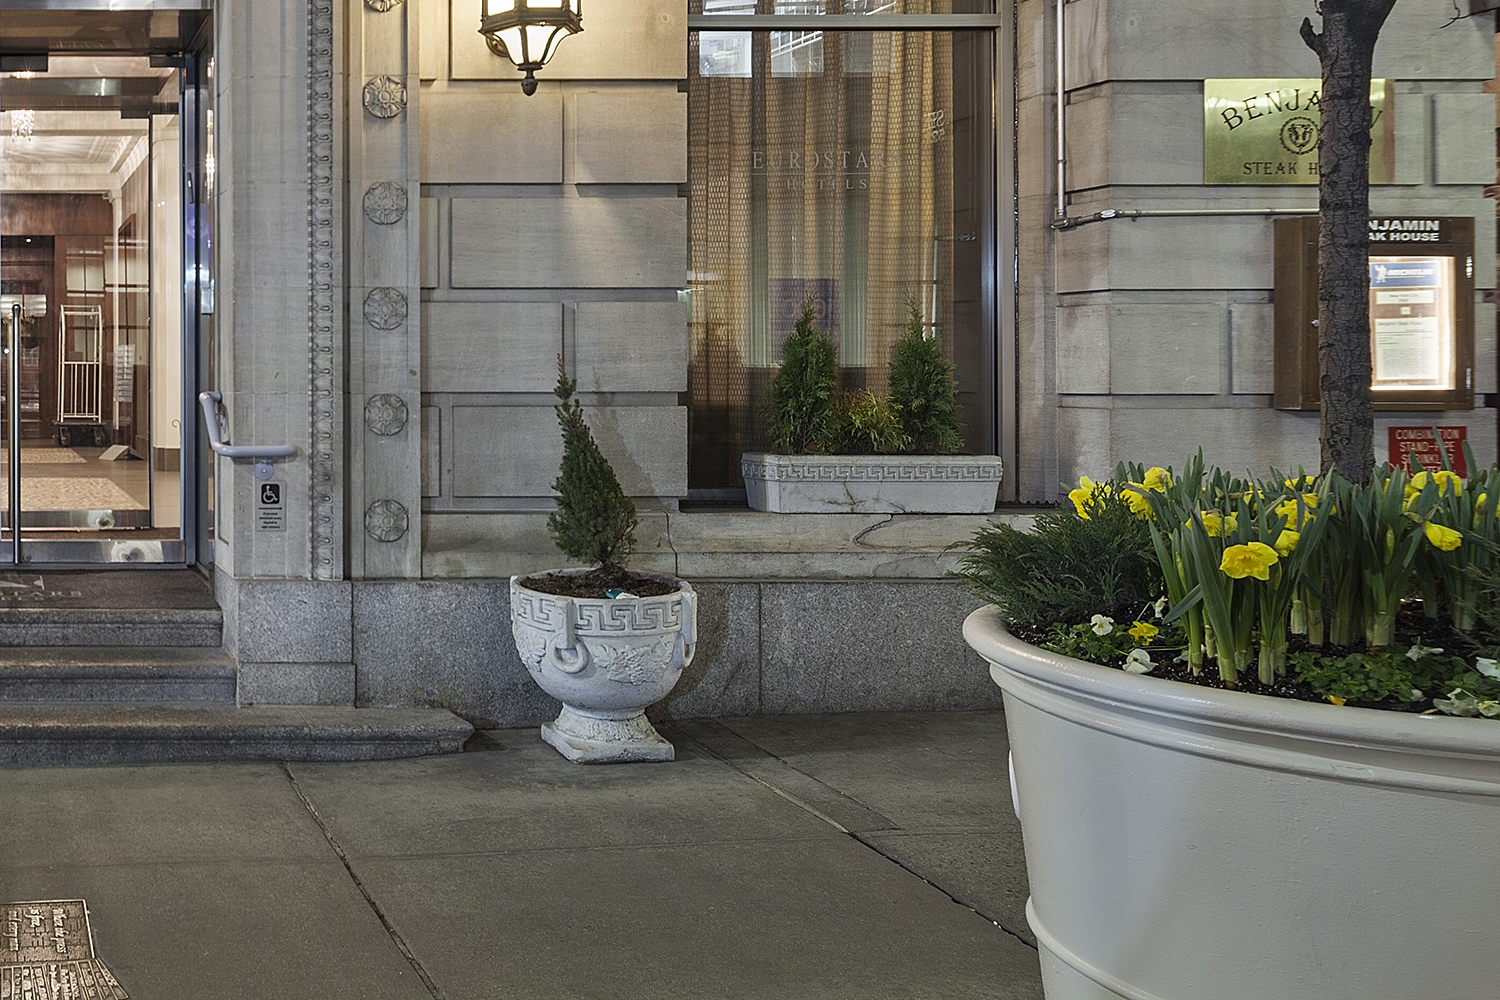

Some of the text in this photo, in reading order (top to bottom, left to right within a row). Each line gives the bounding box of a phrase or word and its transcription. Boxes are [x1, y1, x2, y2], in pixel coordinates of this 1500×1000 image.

[1220, 88, 1384, 132] BENJA
[752, 151, 902, 170] EUROSTAR
[1243, 162, 1298, 176] STEAK
[1368, 219, 1440, 231] NJAMIN
[1389, 232, 1440, 241] HOUSE
[1395, 429, 1461, 440] COMBINTION
